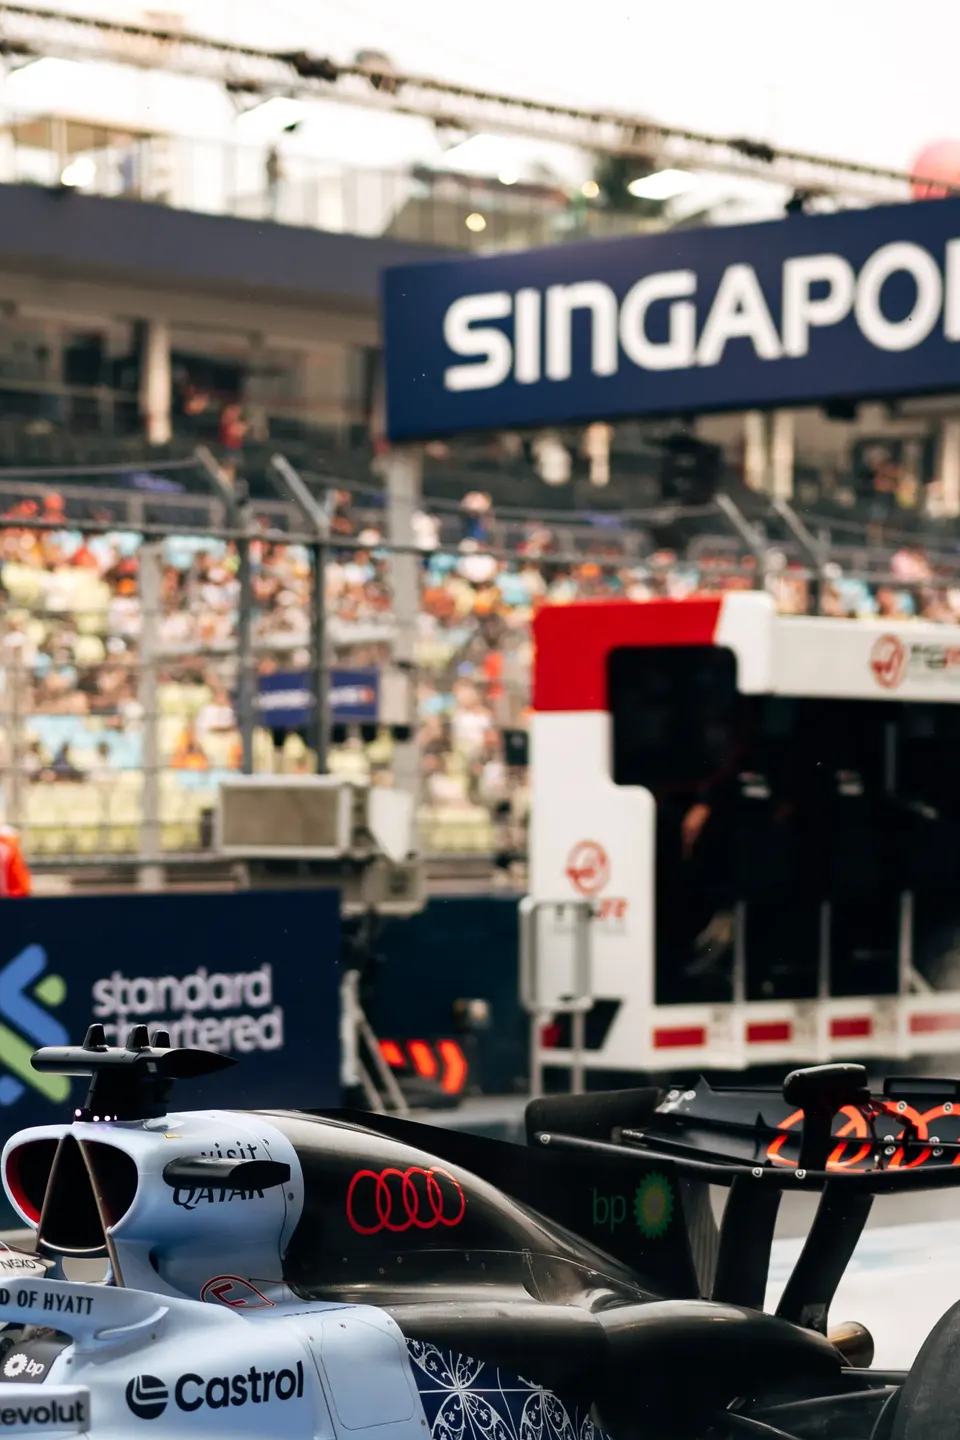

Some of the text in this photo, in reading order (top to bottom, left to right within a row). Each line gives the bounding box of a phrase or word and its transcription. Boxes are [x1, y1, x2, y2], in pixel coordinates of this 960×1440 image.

[92, 962, 273, 1017] standard
[593, 1186, 627, 1235] bp
[0, 1257, 37, 1271] NEXO
[16, 1289, 39, 1308] OF
[43, 1294, 95, 1316] HYATT
[26, 1359, 45, 1378] bp
[174, 1361, 304, 1413] Castrol
